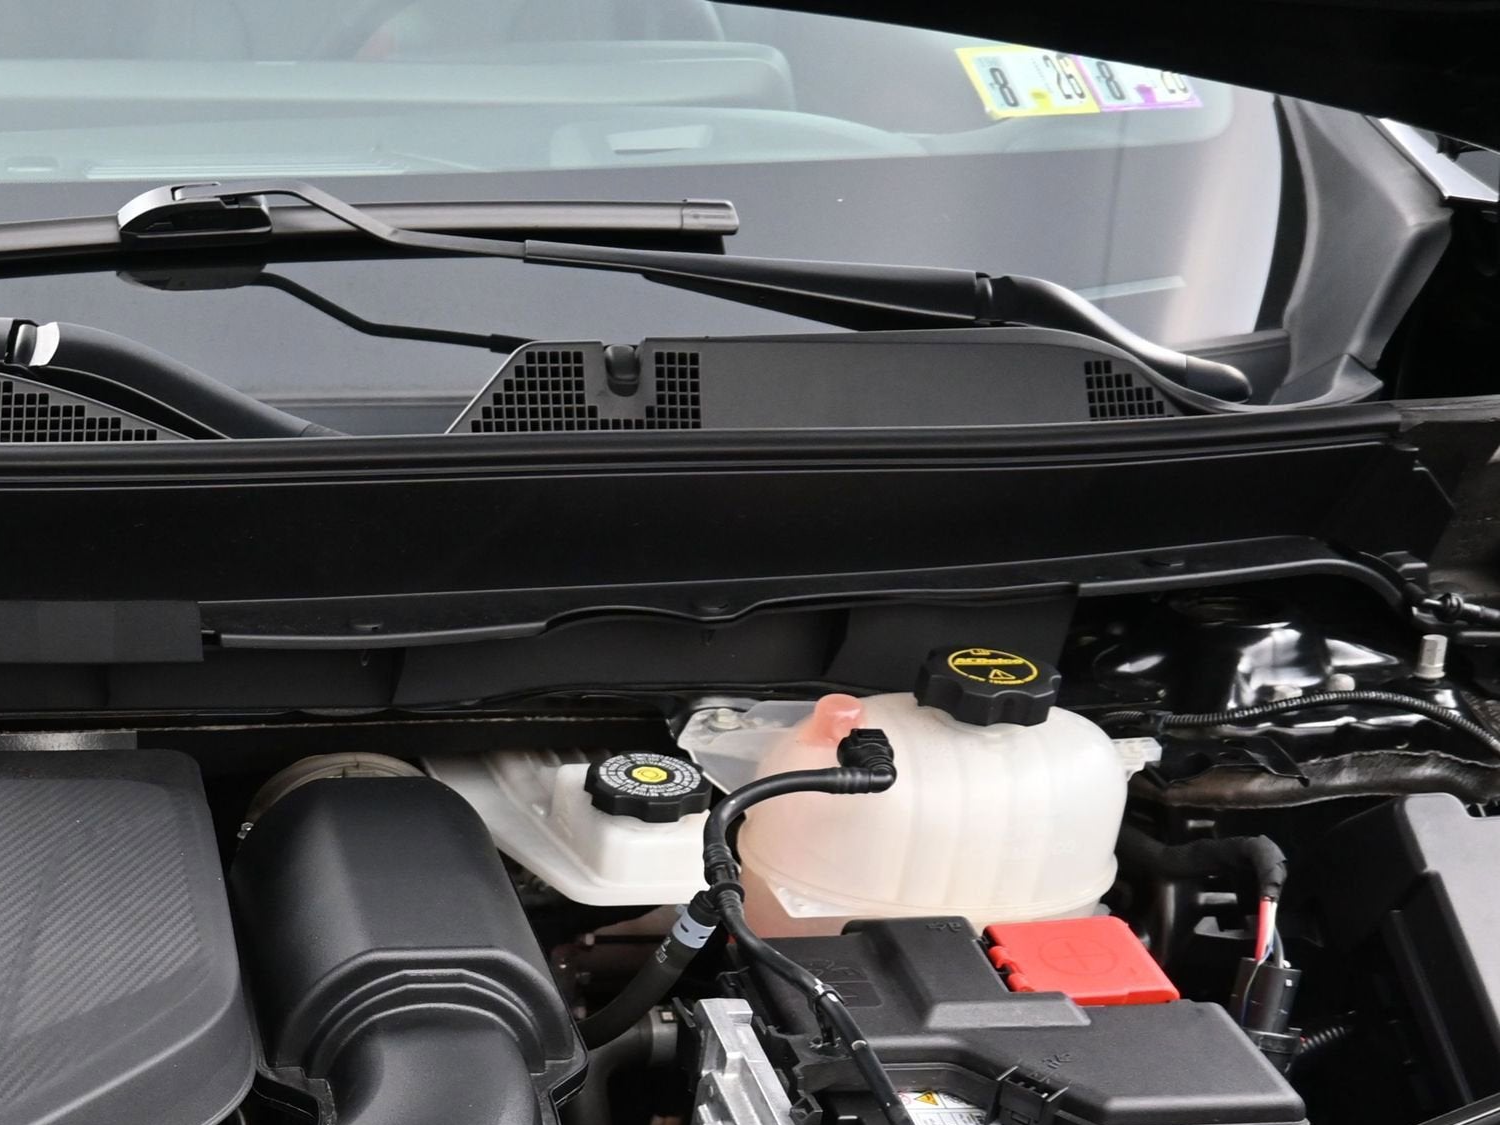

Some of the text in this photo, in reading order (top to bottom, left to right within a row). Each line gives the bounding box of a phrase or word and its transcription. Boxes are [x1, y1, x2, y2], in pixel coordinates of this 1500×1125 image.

[990, 54, 1085, 107] 8 26
[1096, 60, 1125, 101] 8
